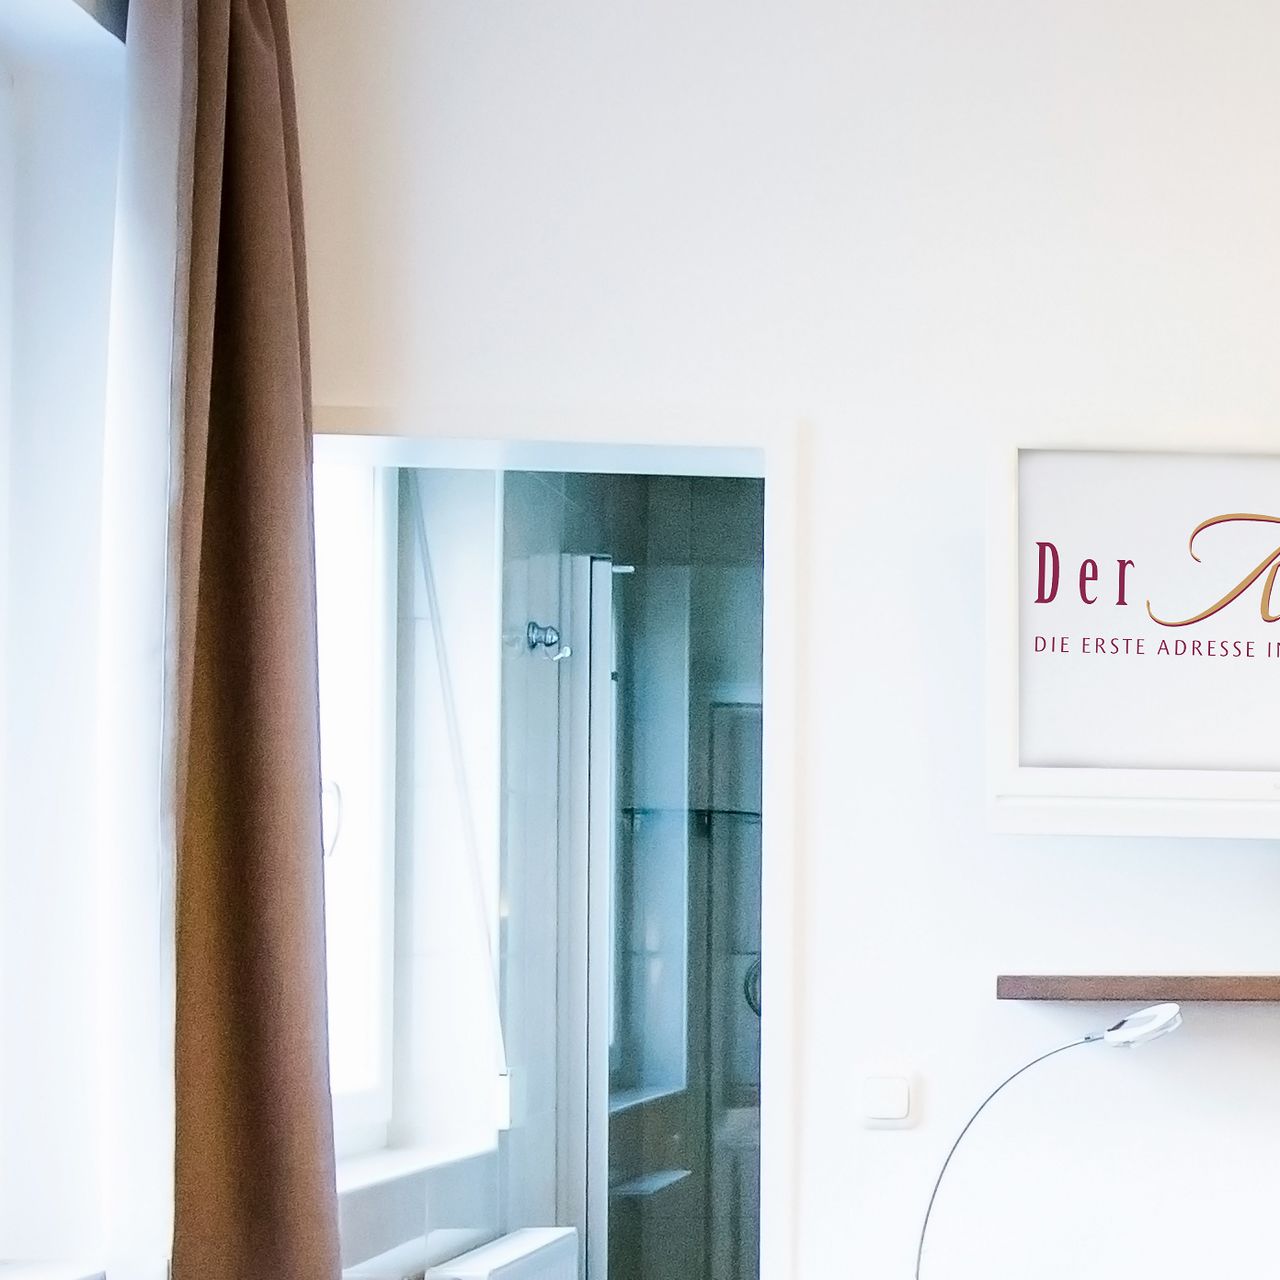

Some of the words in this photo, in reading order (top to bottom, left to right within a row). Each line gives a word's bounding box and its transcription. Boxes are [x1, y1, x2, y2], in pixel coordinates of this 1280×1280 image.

[1034, 541, 1135, 606] Der
[1034, 636, 1070, 653] DIE
[1082, 637, 1145, 655] ERSTE
[1157, 639, 1255, 658] ADRESSE
